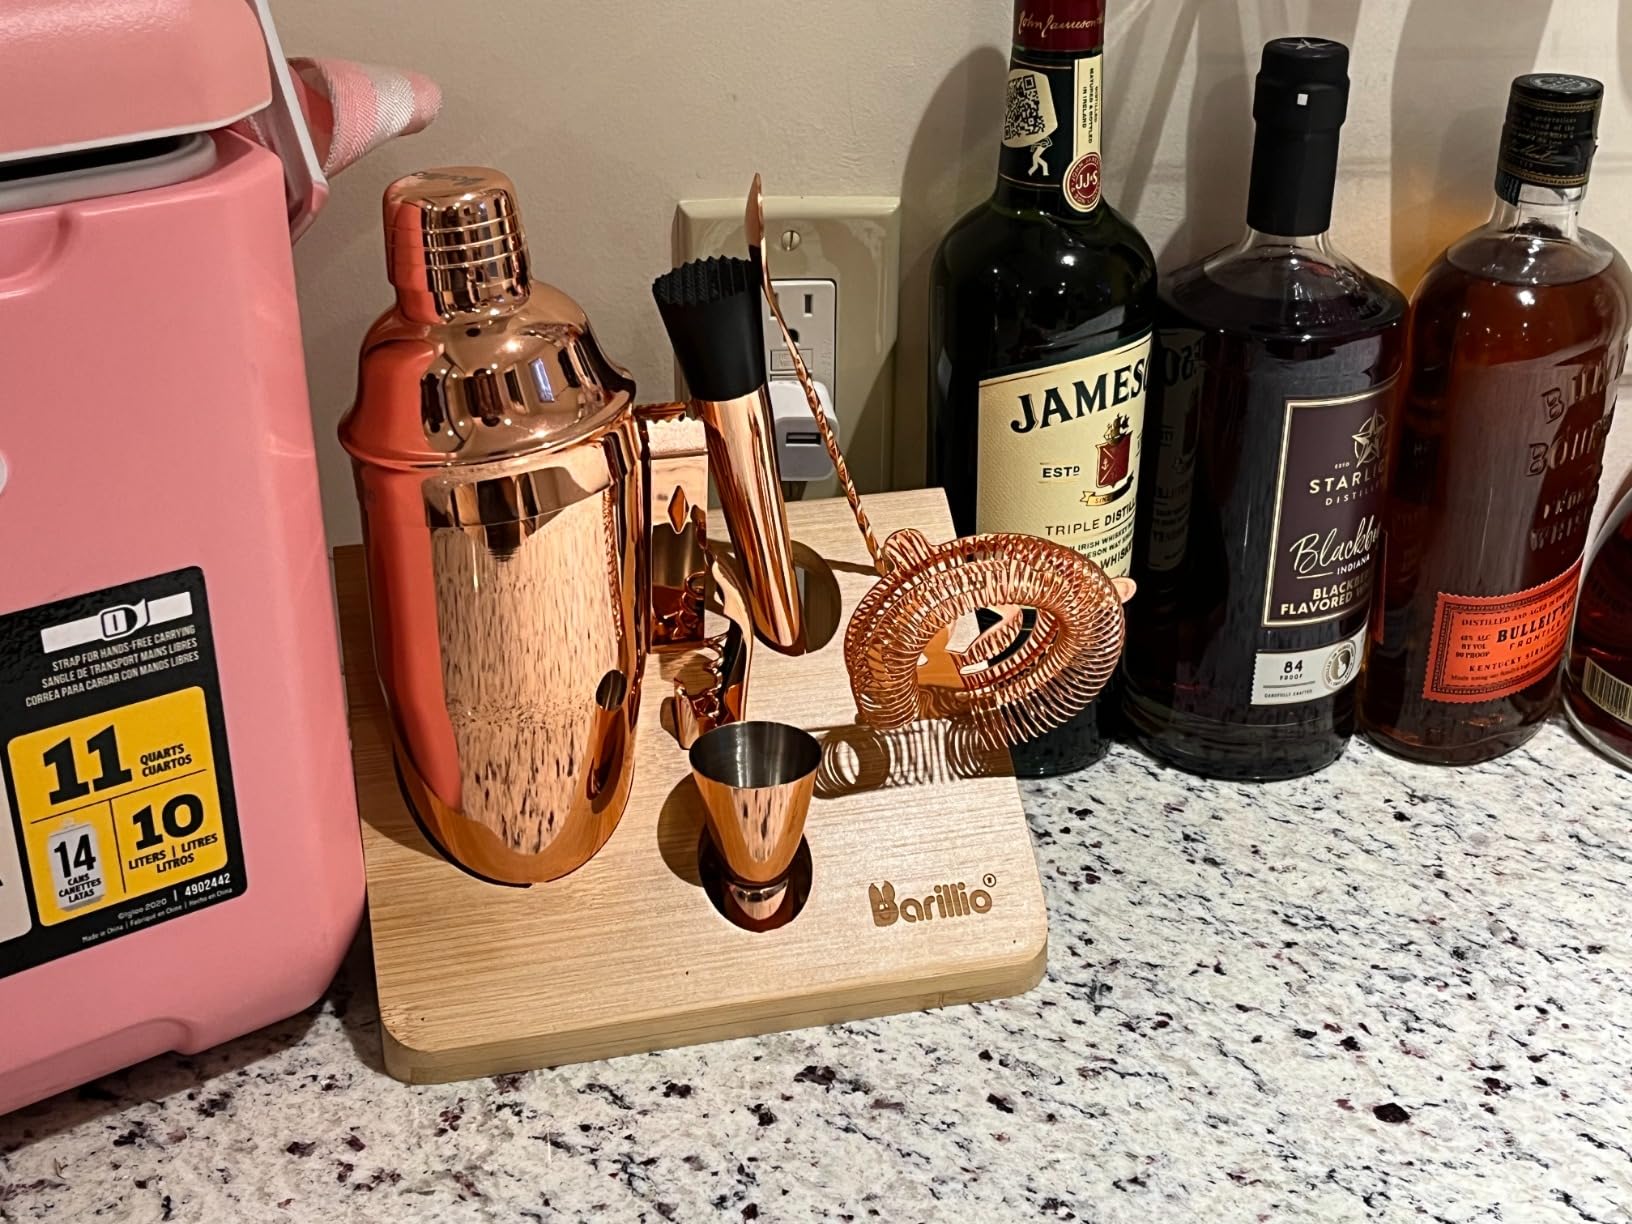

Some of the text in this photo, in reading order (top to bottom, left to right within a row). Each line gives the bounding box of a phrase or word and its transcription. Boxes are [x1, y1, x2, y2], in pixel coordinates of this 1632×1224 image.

[1045, 519, 1100, 536] TRIPLE
[1078, 540, 1100, 551] IRISH
[1281, 591, 1352, 615] FLAVORED
[1462, 615, 1510, 626] DISTILLED
[52, 624, 196, 671] STRAP FOR HANDS-FREE CARRYING
[42, 638, 197, 688] SANGLE DE TRANSPORT MAINS LIBRES
[1284, 659, 1303, 673] 84
[1469, 657, 1521, 672] KENTUCKY
[26, 651, 199, 707] CORREA PARA CARGAR CON MANOS LIBRES
[43, 724, 132, 806] 11
[140, 744, 185, 765] QUARTS
[142, 754, 192, 777] CUARTOS
[132, 793, 204, 850] 10
[54, 834, 96, 878] 14
[128, 833, 218, 870] LITERS LITRES
[156, 853, 194, 873] LITROS
[58, 877, 102, 898] CANETTES
[67, 873, 90, 886] CANS
[185, 873, 231, 896] 4902442
[68, 888, 95, 903] LATAS
[145, 898, 167, 911] 2020
[189, 897, 207, 906] Hecho
[216, 888, 233, 897] China
[82, 933, 98, 943] Made
[106, 925, 124, 934] China
